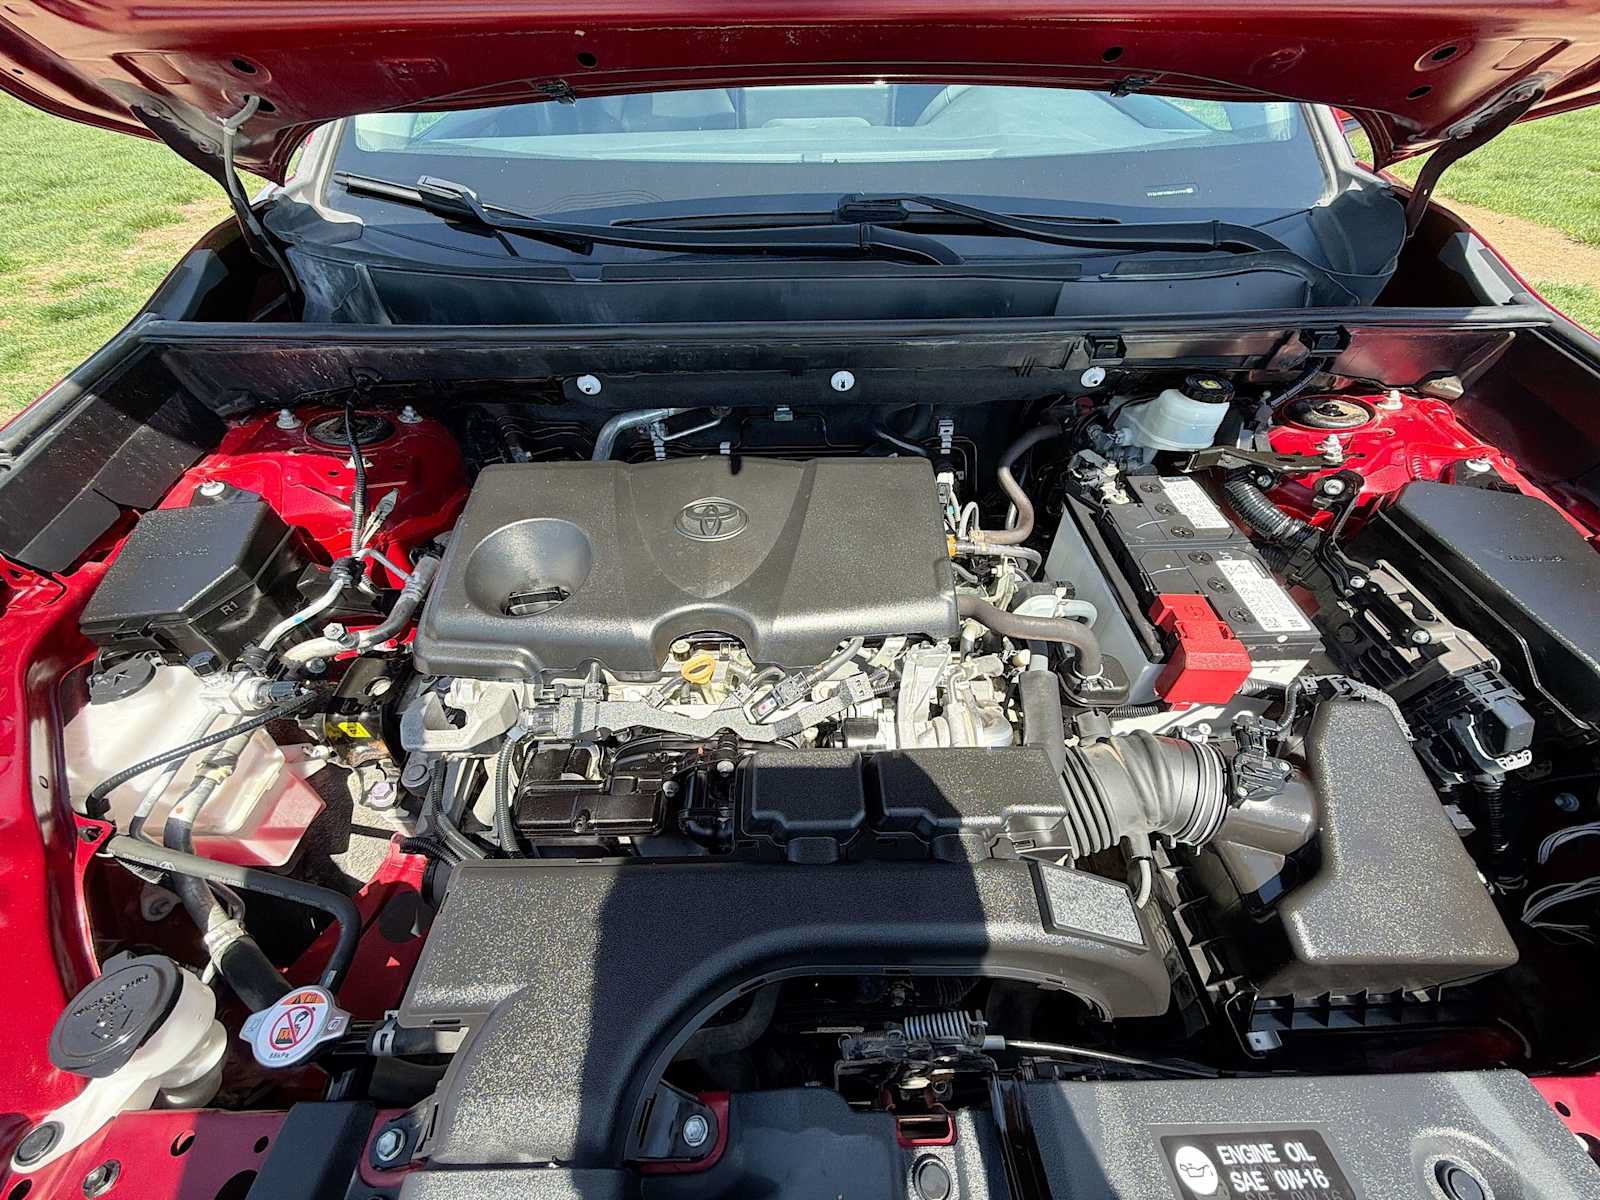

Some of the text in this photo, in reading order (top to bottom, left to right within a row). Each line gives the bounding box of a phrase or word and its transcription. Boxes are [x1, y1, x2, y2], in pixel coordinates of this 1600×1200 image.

[220, 600, 239, 615] R1
[1216, 1142, 1317, 1165] ENGINE OIL
[1230, 1168, 1331, 1193] SAE 0W-16
